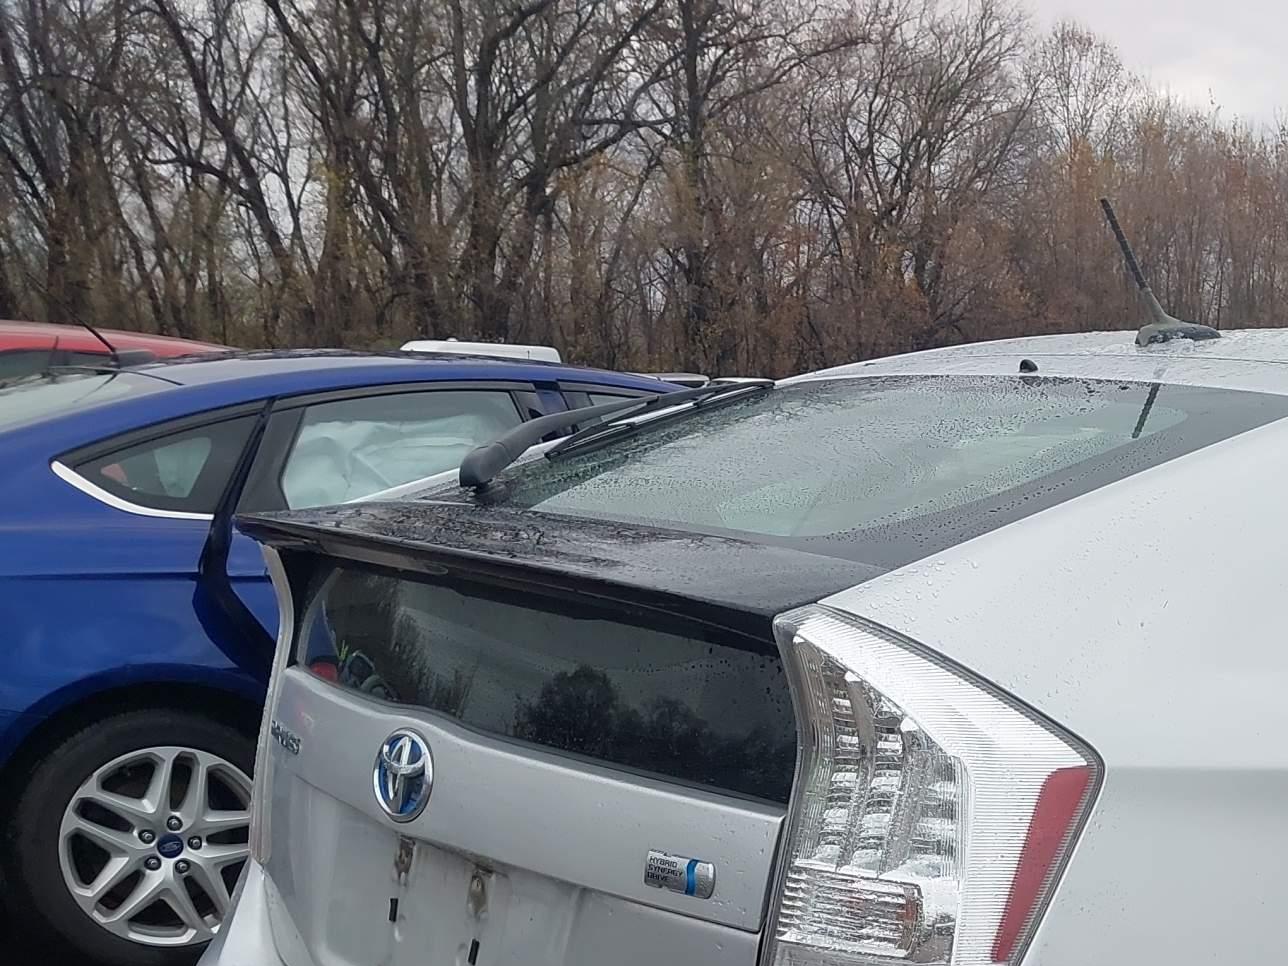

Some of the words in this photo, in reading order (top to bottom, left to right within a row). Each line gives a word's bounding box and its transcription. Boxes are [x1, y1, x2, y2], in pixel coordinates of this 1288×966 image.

[649, 855, 678, 868] HYBRID
[647, 871, 669, 881] DRIVE
[648, 864, 683, 878] SYNERGY
